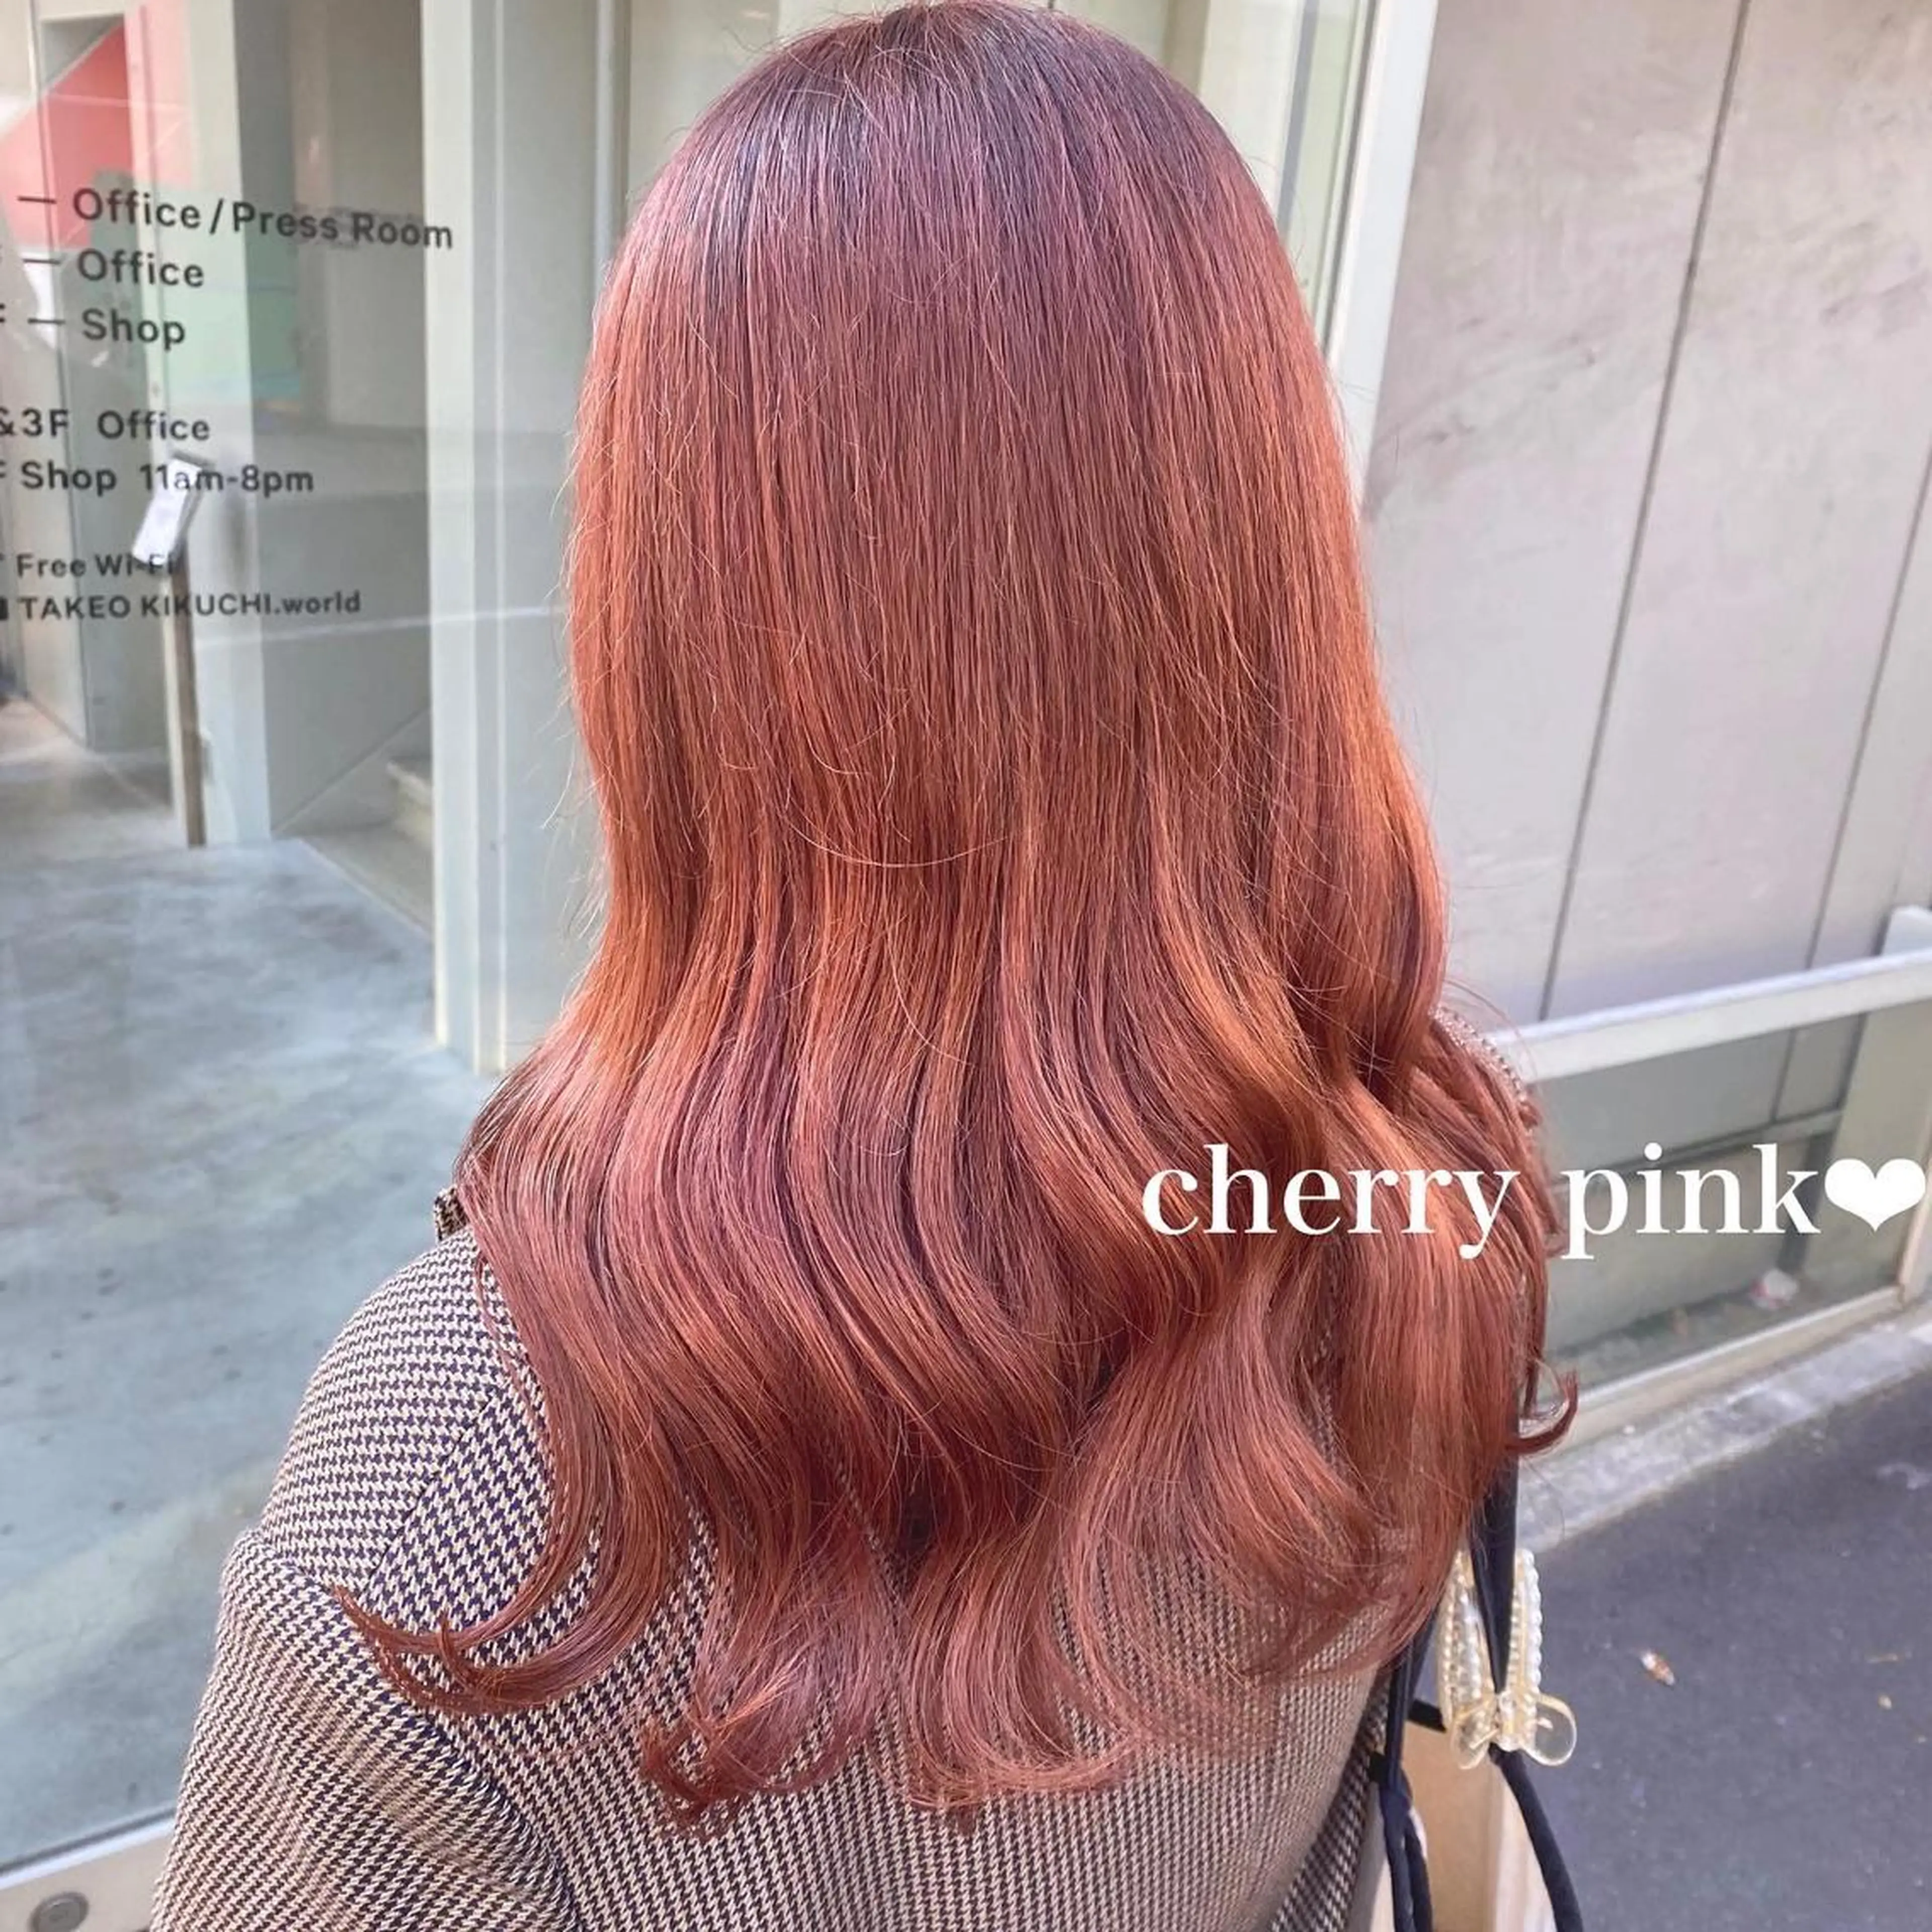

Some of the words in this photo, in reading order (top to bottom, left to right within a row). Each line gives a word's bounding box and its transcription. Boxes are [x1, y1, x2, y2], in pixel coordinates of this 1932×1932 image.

[352, 212, 453, 248] Room
[77, 248, 204, 287] Office
[82, 308, 185, 351] Shop
[97, 410, 210, 441] Office
[21, 459, 117, 496] Shop
[140, 464, 314, 497] 11am-8pm
[16, 553, 86, 577] Free
[17, 595, 130, 620] TAKEO
[141, 591, 361, 617] KIKUCHI.world
